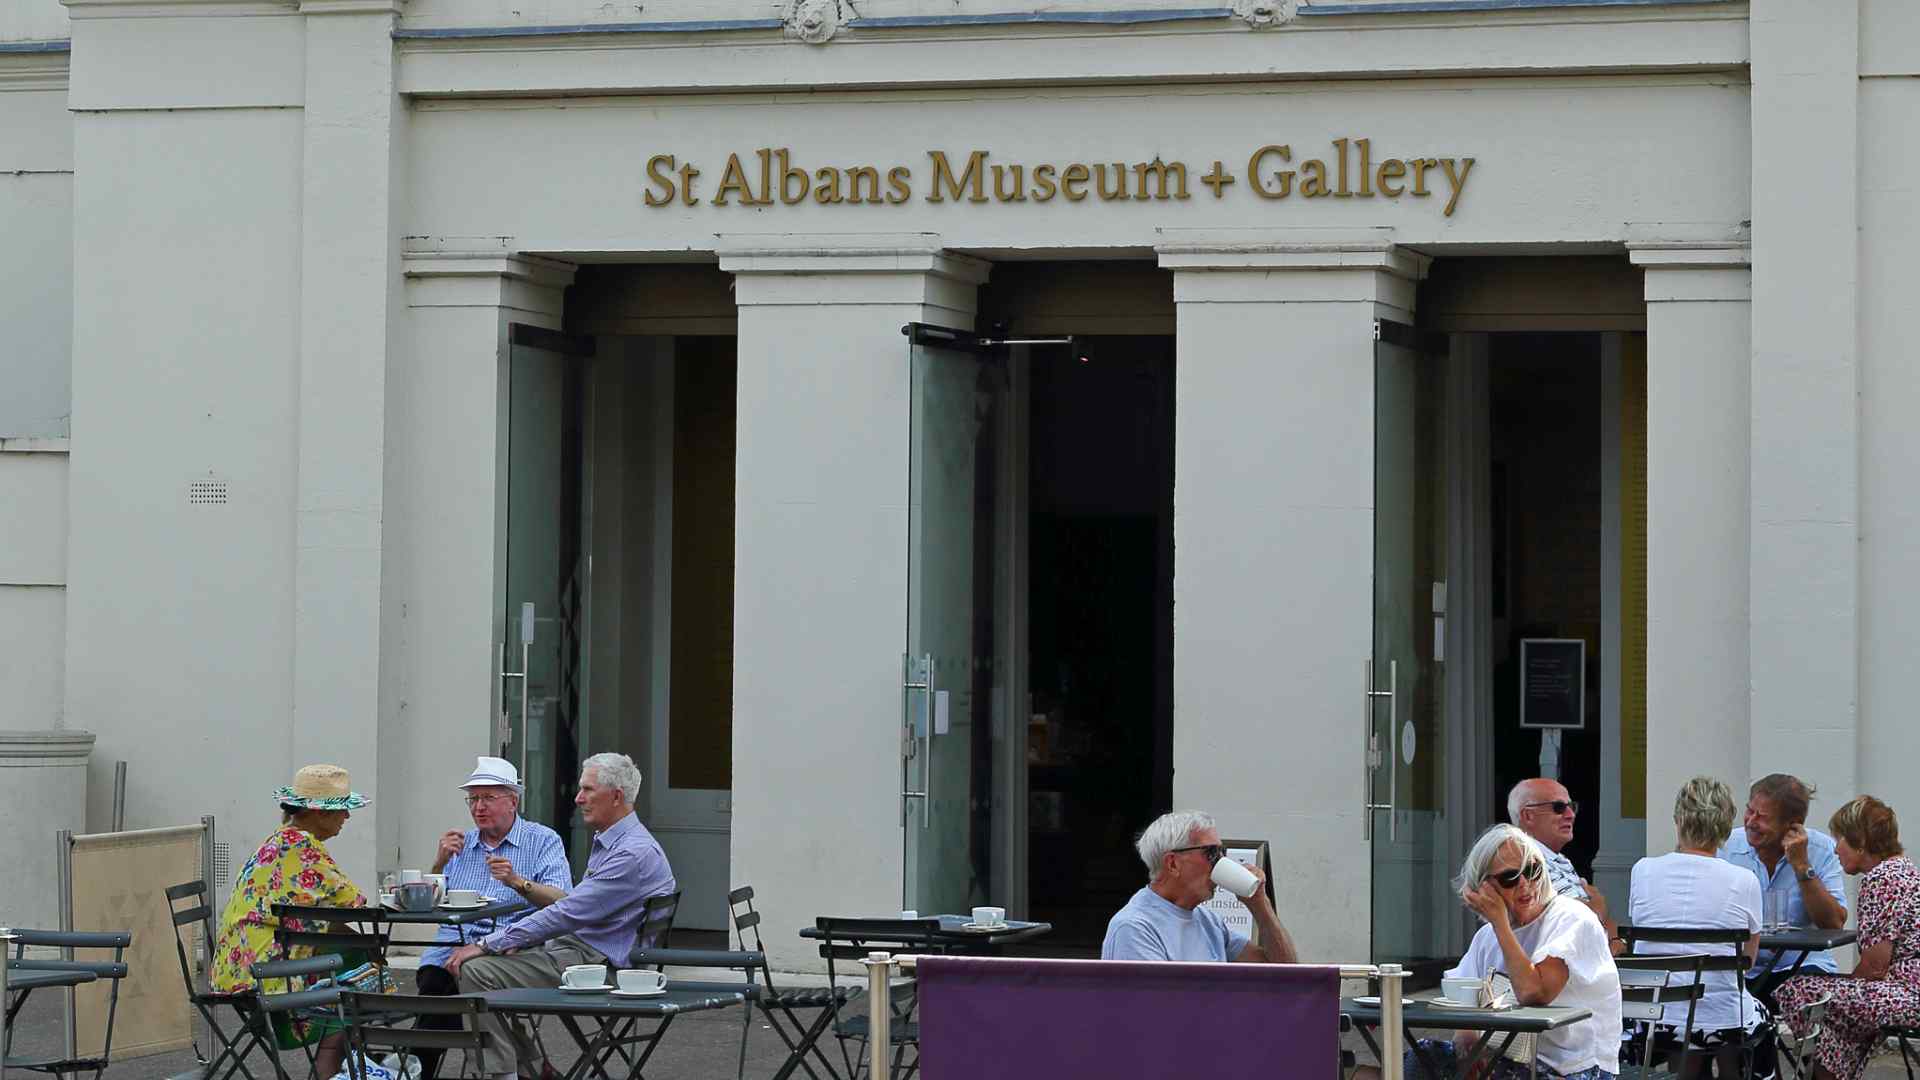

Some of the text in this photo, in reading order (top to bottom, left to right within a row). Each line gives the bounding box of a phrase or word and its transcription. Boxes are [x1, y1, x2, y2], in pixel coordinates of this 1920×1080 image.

[645, 155, 699, 208] St
[711, 149, 912, 207] Albans
[926, 150, 1190, 203] Museum
[1247, 138, 1475, 217] Gallery
[1221, 915, 1249, 925] oom
